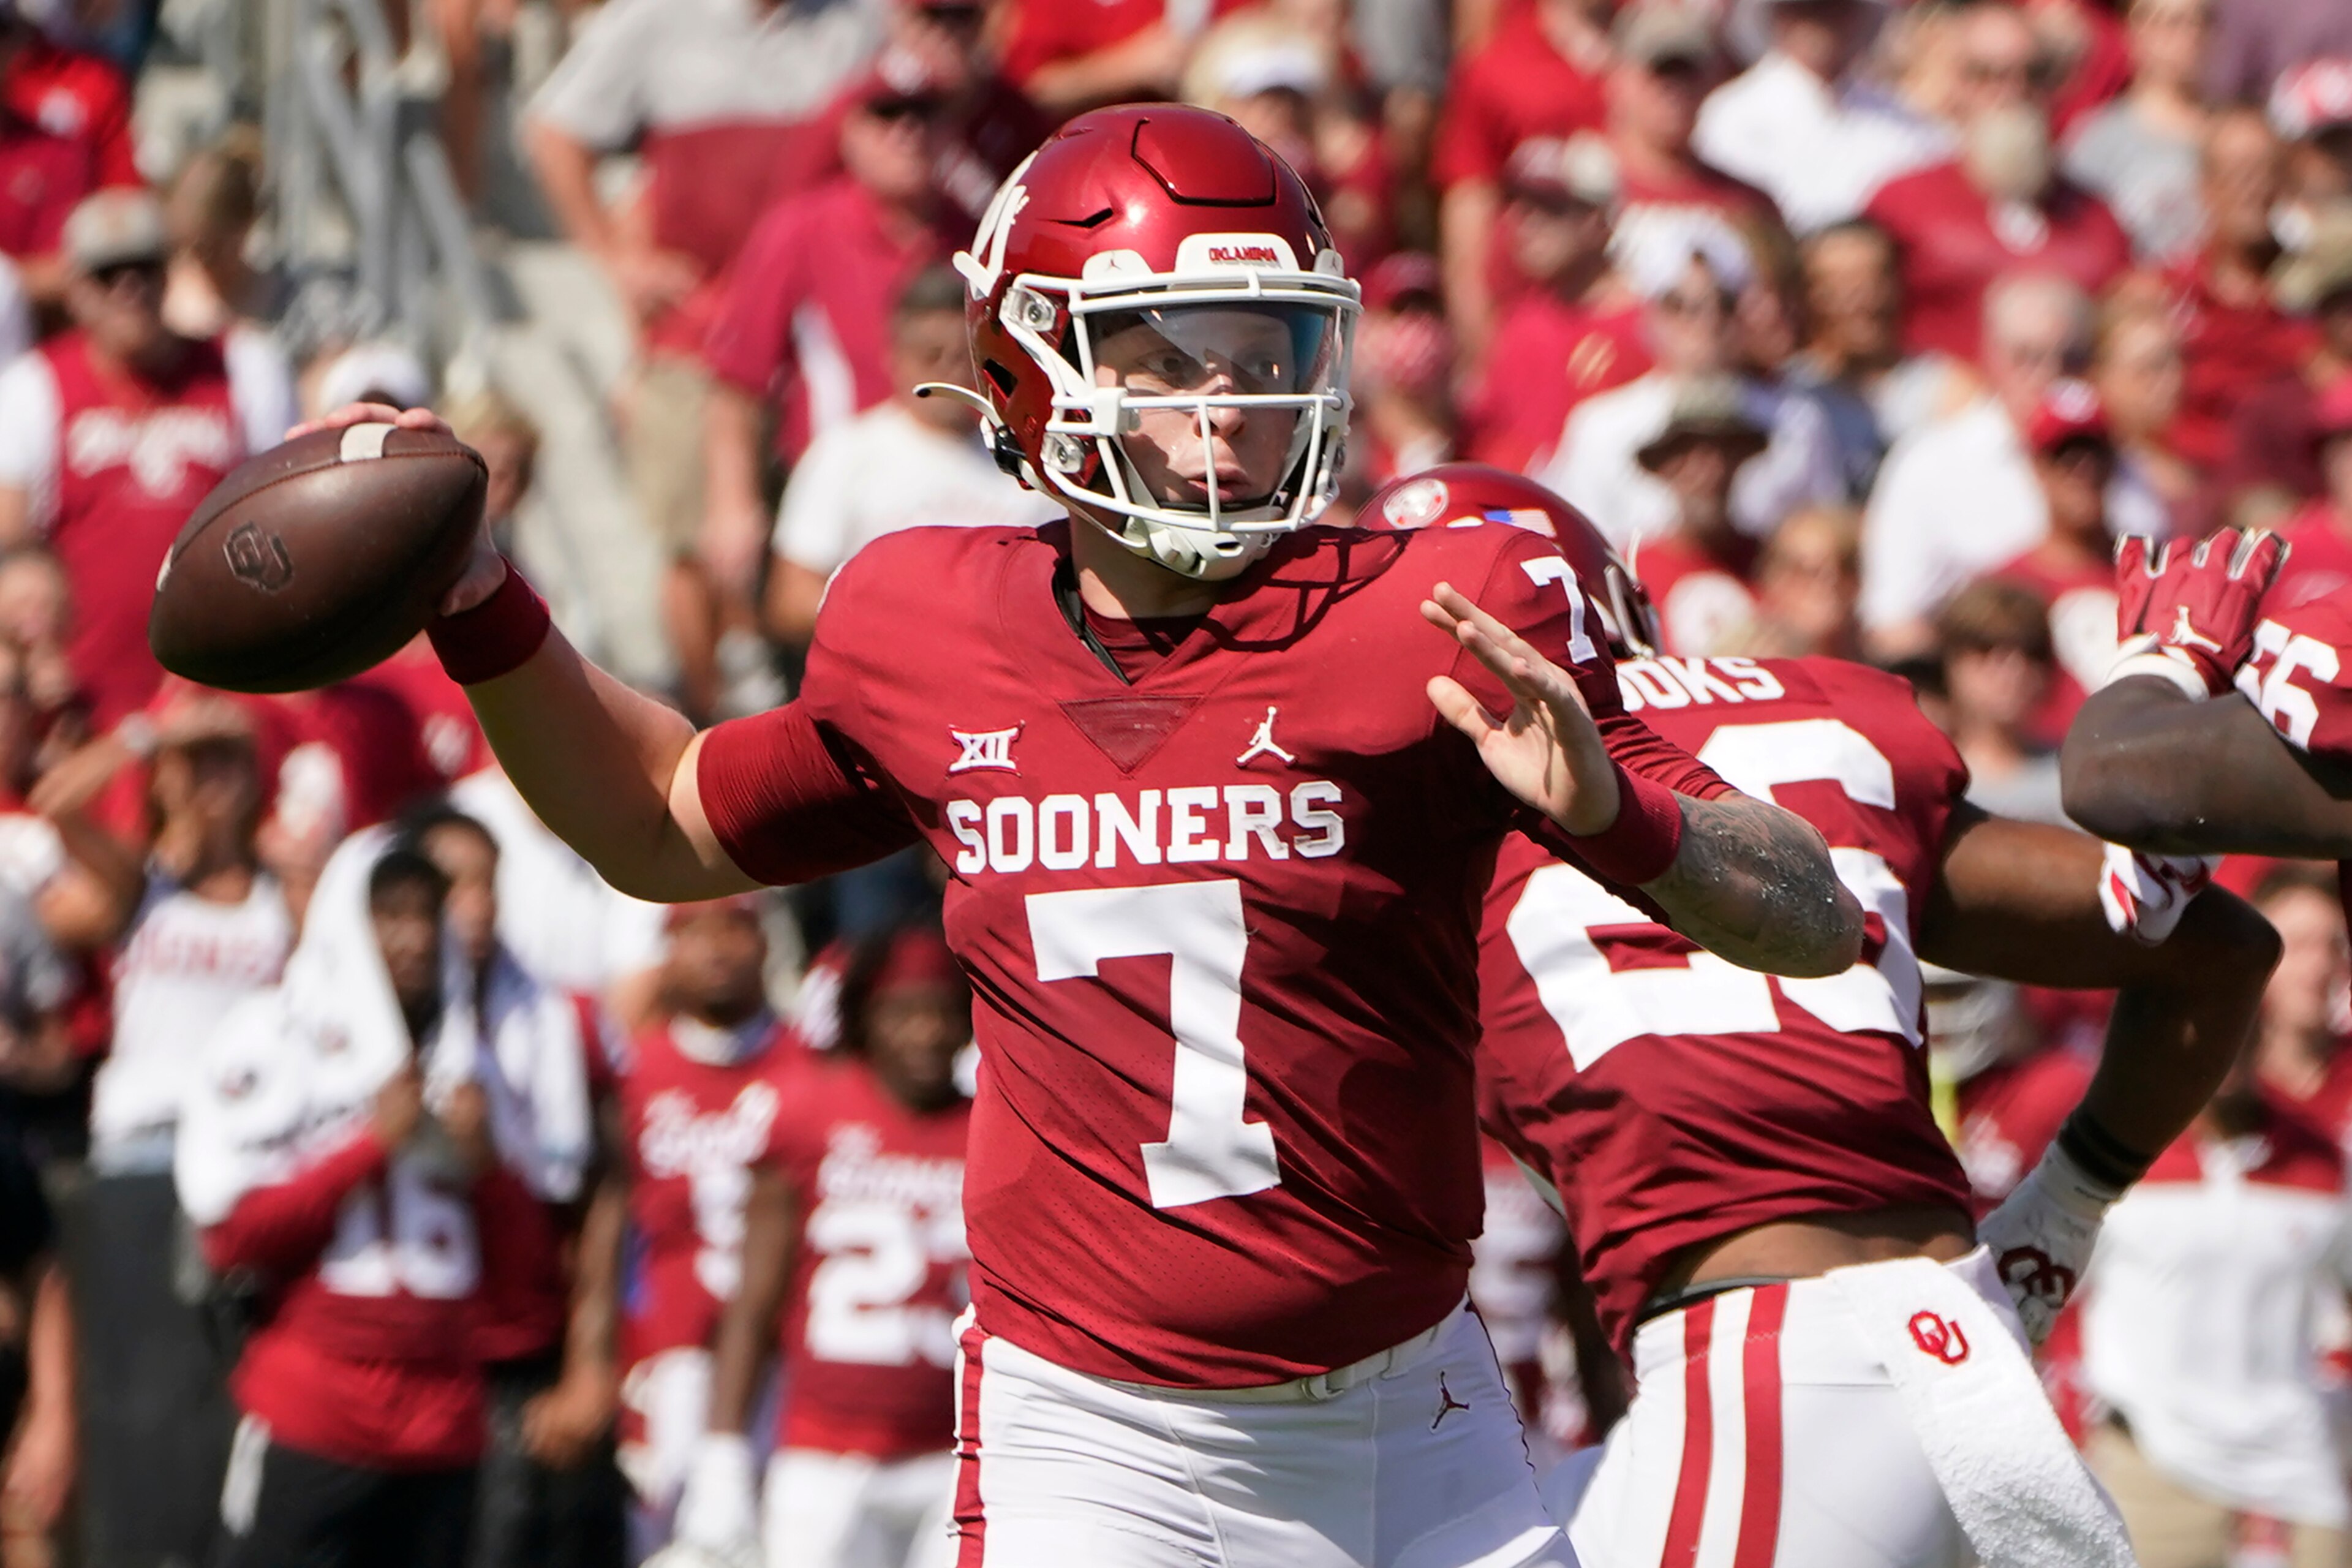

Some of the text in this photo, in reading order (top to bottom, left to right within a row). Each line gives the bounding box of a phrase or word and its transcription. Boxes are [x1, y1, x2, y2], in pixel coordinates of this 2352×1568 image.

[1520, 556, 1597, 664] 7
[948, 724, 1022, 774] XII
[945, 780, 1346, 875] SOONERS
[1025, 878, 1282, 1209] 7
[1908, 1310, 1969, 1366] OU
